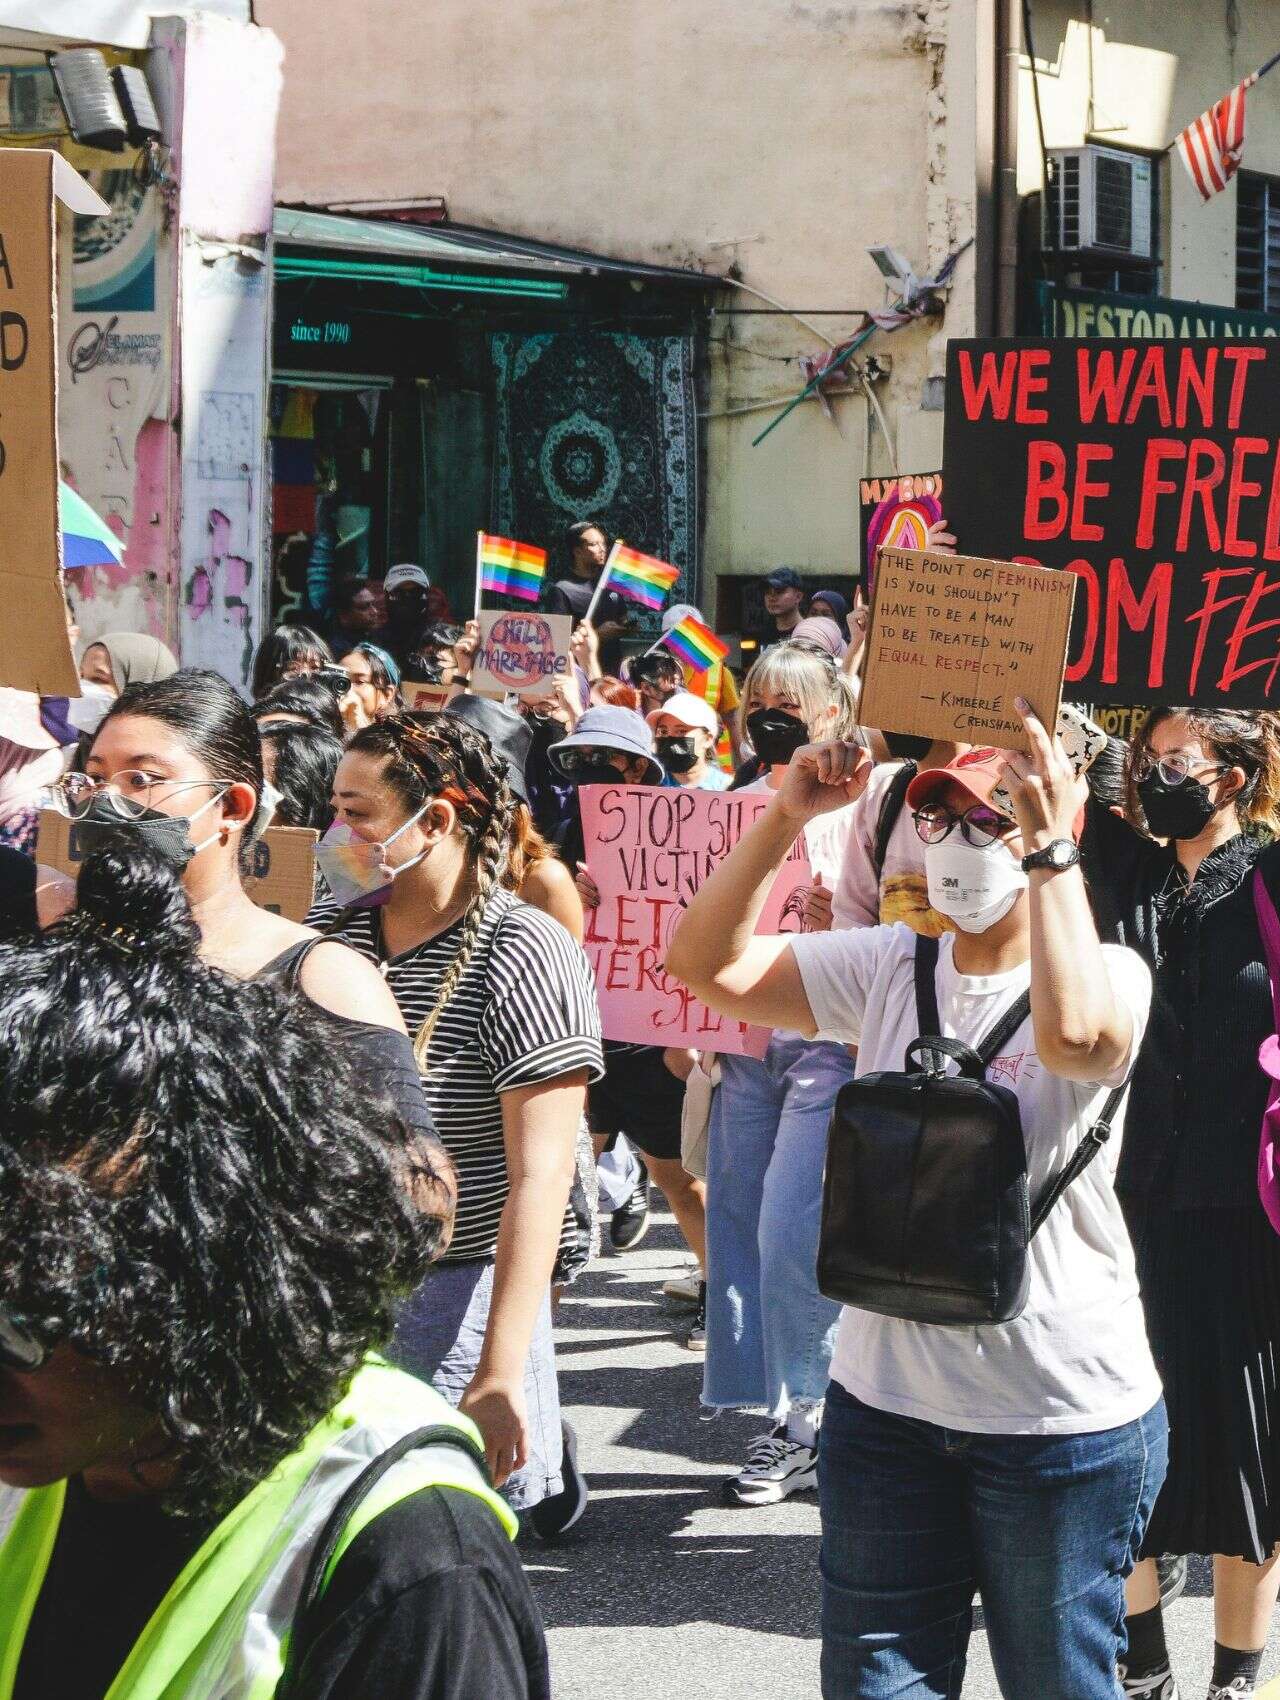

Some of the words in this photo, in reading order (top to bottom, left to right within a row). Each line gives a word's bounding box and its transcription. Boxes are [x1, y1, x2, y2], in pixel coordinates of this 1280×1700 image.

[291, 317, 320, 341] since
[324, 321, 350, 344] 1990
[958, 349, 1050, 424] WE
[1076, 346, 1266, 429] WANT
[860, 479, 897, 505] MY
[1022, 440, 1113, 541] BE
[884, 577, 898, 589] IS
[908, 579, 935, 596] YOU
[922, 558, 965, 576] POINT
[973, 566, 993, 579] OF
[996, 572, 1072, 595] FEMINISM
[881, 603, 916, 618] HAVE
[925, 606, 941, 618] TO
[946, 609, 962, 622] BE
[969, 610, 977, 622] A
[985, 612, 1014, 628] MAN
[1011, 557, 1174, 688] OM
[491, 619, 552, 645] CHILD
[881, 625, 895, 638] TO
[902, 628, 917, 642] BE
[930, 628, 990, 648] TREATED
[1000, 639, 1034, 655] WITH
[480, 649, 568, 675] MARRIAGE
[878, 647, 927, 667] EQUAL
[596, 789, 697, 849] STOP
[941, 877, 958, 888] 3M
[584, 895, 676, 949] LET
